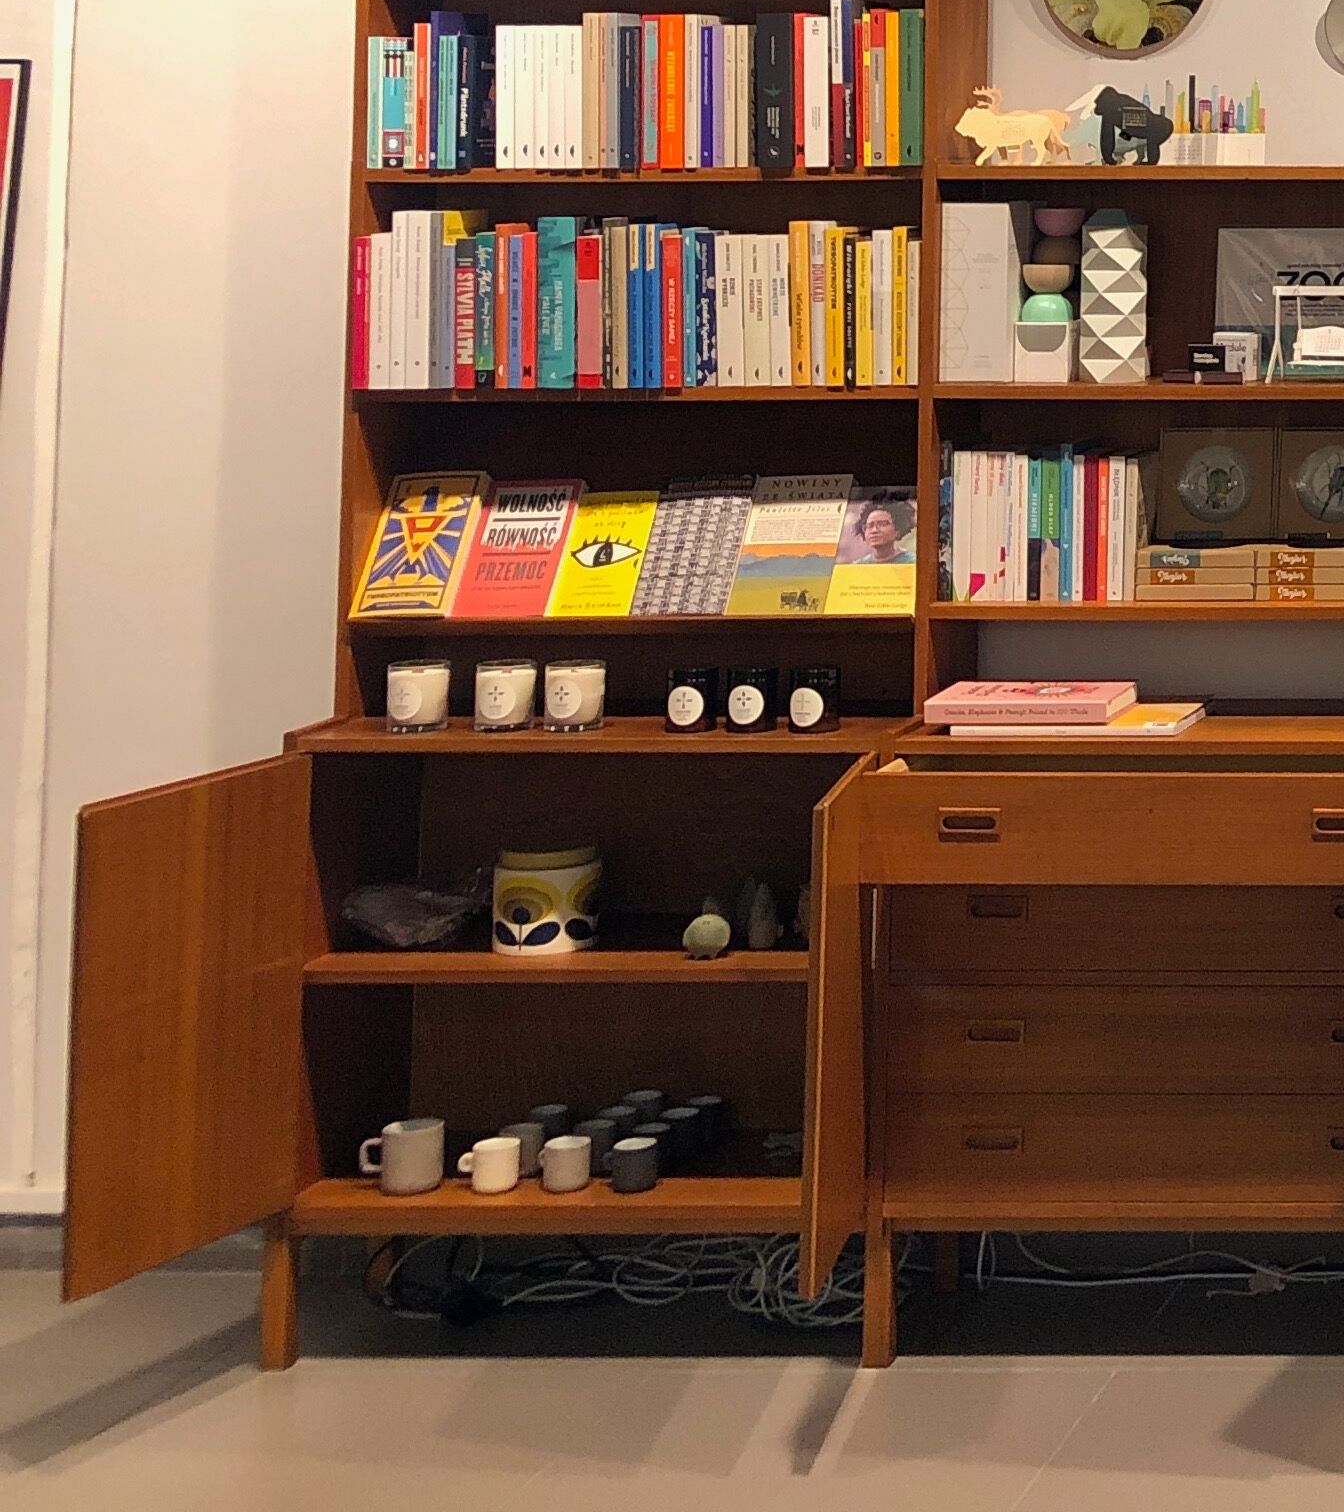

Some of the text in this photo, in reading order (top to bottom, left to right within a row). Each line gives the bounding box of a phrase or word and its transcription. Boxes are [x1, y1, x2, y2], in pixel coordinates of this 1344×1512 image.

[457, 273, 473, 317] SYLVIA
[771, 477, 843, 489] NOWINY
[497, 487, 567, 513] WOLNOŚĆ
[762, 490, 846, 501] ZE ŚWIATA
[487, 523, 558, 548] RÓWNOŚĆ
[475, 560, 548, 581] PRZEMOC
